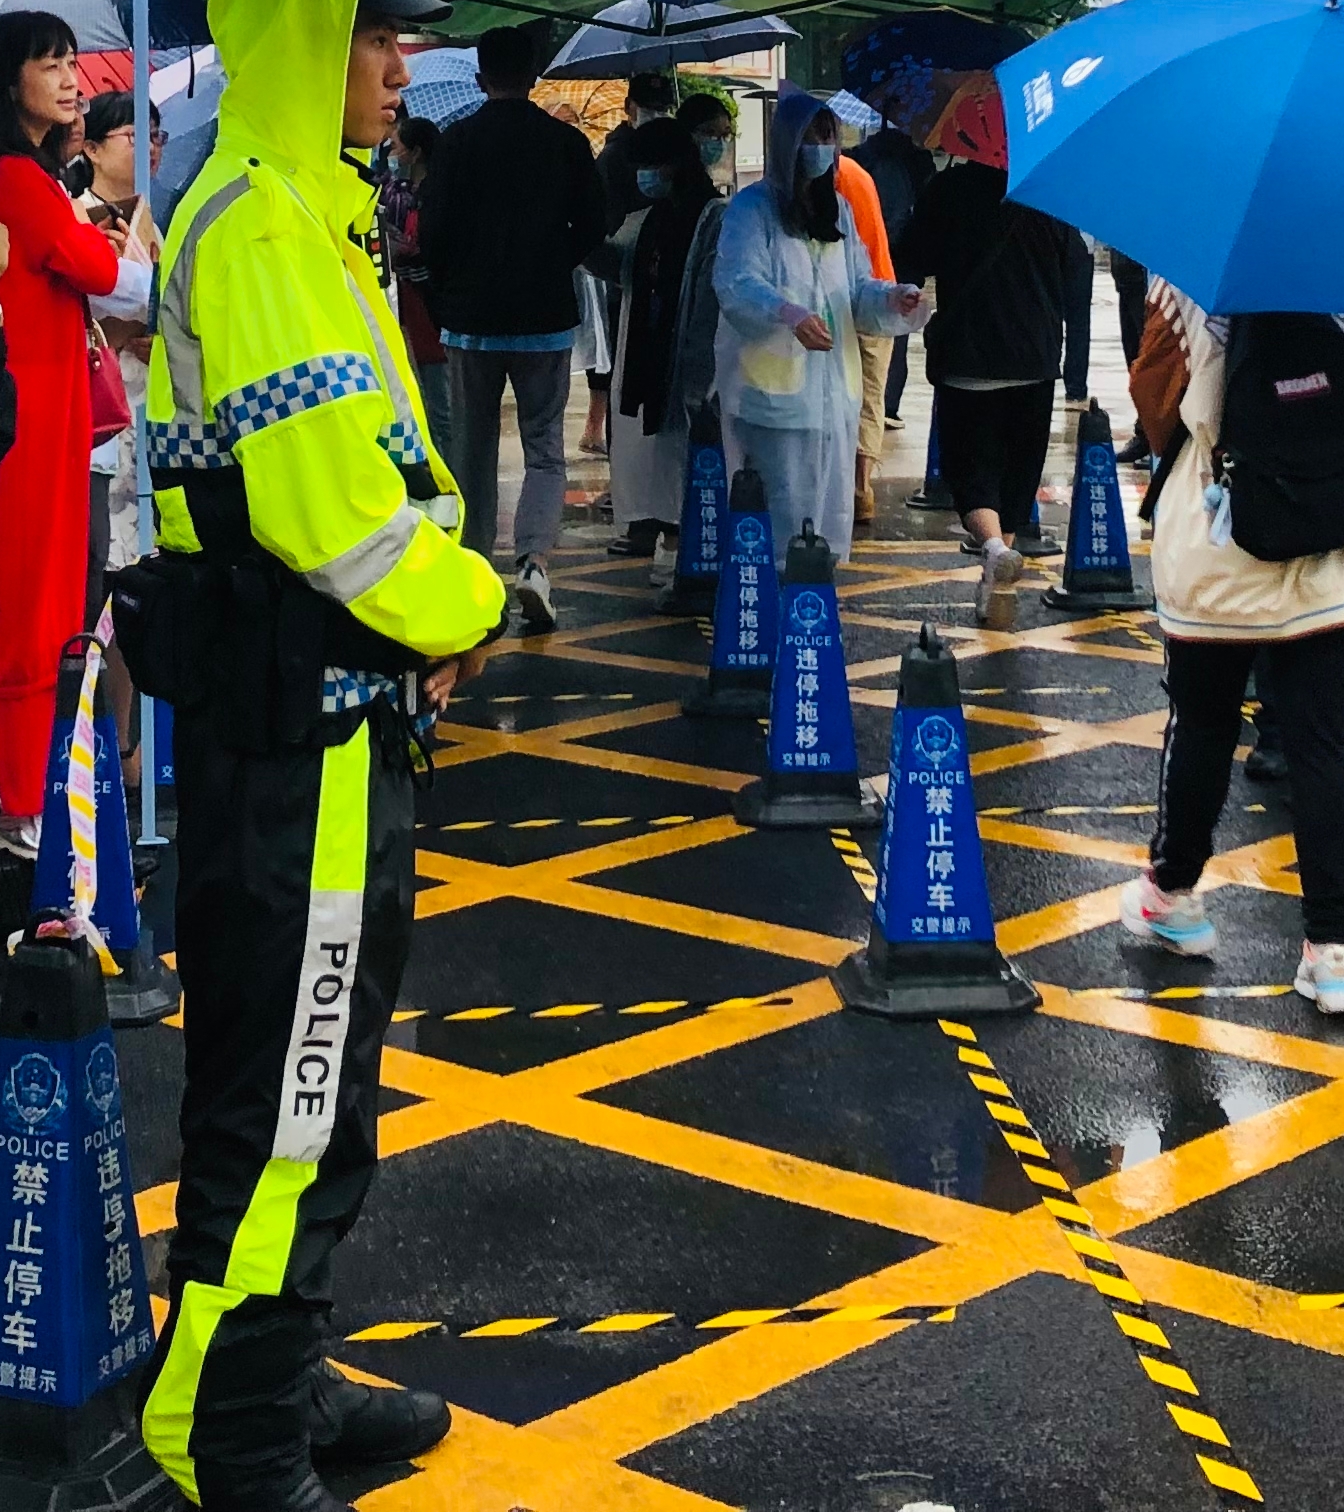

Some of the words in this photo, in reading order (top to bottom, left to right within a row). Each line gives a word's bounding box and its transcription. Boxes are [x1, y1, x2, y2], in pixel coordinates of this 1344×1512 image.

[730, 554, 770, 565] POLICE
[738, 565, 759, 650] 违停拖移
[785, 634, 832, 647] POLICE
[795, 647, 819, 750] 违停拖移
[53, 780, 112, 794] PCE
[908, 770, 965, 785] POLICE
[925, 785, 956, 913] 禁止停车
[911, 916, 972, 934] 交警提示
[293, 941, 350, 1117] POLICE
[1, 1159, 50, 1356] 禁止停车
[97, 1146, 136, 1337] 违停拖移
[98, 1328, 151, 1381] 交警提示
